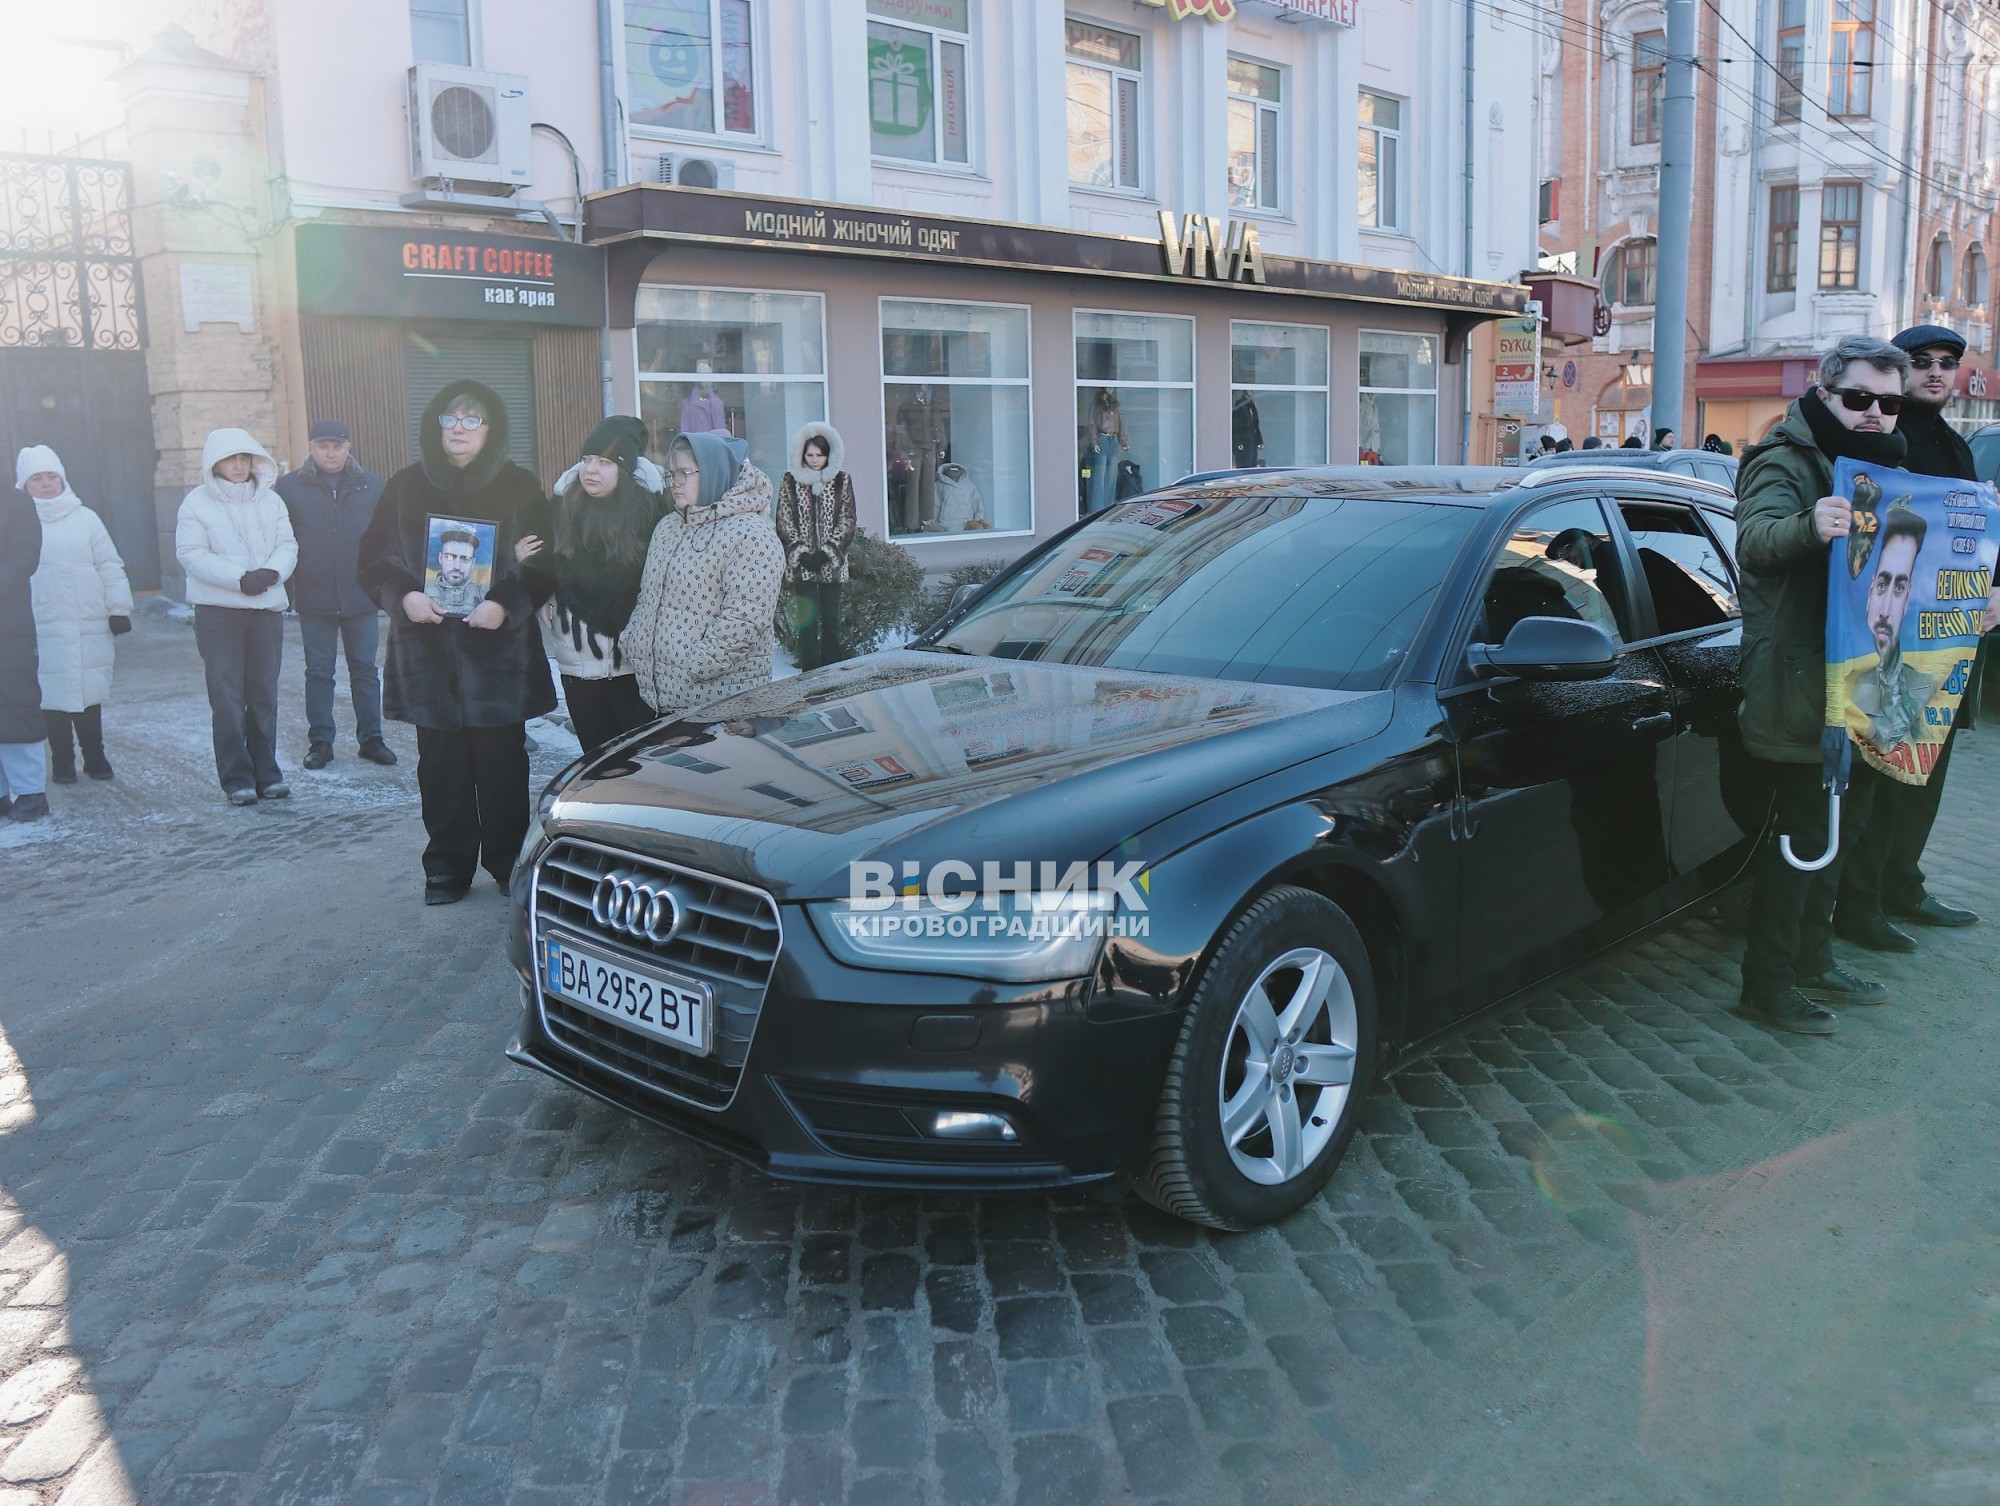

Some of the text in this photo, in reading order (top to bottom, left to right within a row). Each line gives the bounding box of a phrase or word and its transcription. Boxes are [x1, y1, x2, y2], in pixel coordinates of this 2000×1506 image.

[745, 210, 960, 252] МОДНИЙ ЖІНОЧИЙ ОДЯГ
[403, 242, 554, 278] CRAFT COFFEE
[484, 286, 555, 307] кав'ярня
[1397, 280, 1495, 307] МОДНИЙ ЖІНОЧИЙ ОДЯГ
[1500, 338, 1532, 353] БУКИ
[1502, 367, 1508, 375] 2
[1969, 368, 1987, 397] elis
[1937, 566, 1991, 600] ВЕЛИКИЙ
[551, 972, 560, 984] UA
[561, 951, 701, 1037] BA 2952 BT
